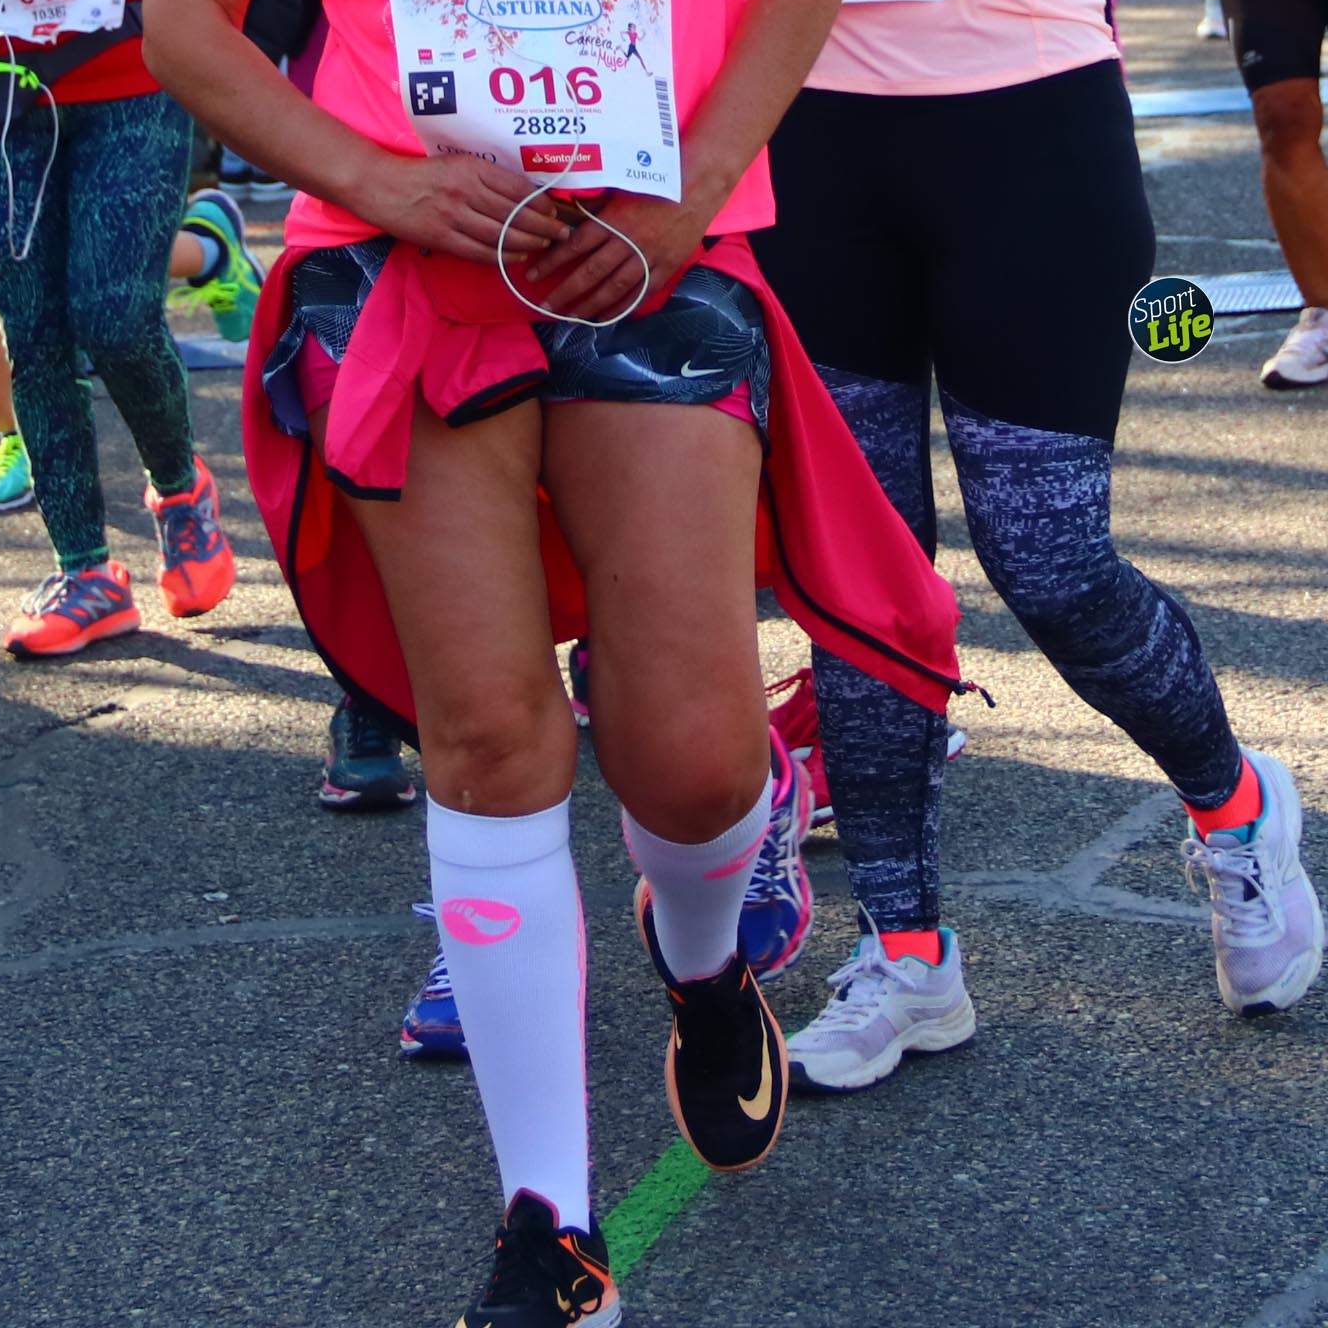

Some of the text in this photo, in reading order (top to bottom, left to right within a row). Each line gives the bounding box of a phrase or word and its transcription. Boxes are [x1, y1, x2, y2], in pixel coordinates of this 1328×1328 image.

[564, 30, 613, 50] Carrera
[597, 47, 628, 72] Mujer
[489, 66, 602, 107] 016
[512, 115, 587, 136] 28825
[626, 168, 666, 184] ZURICH
